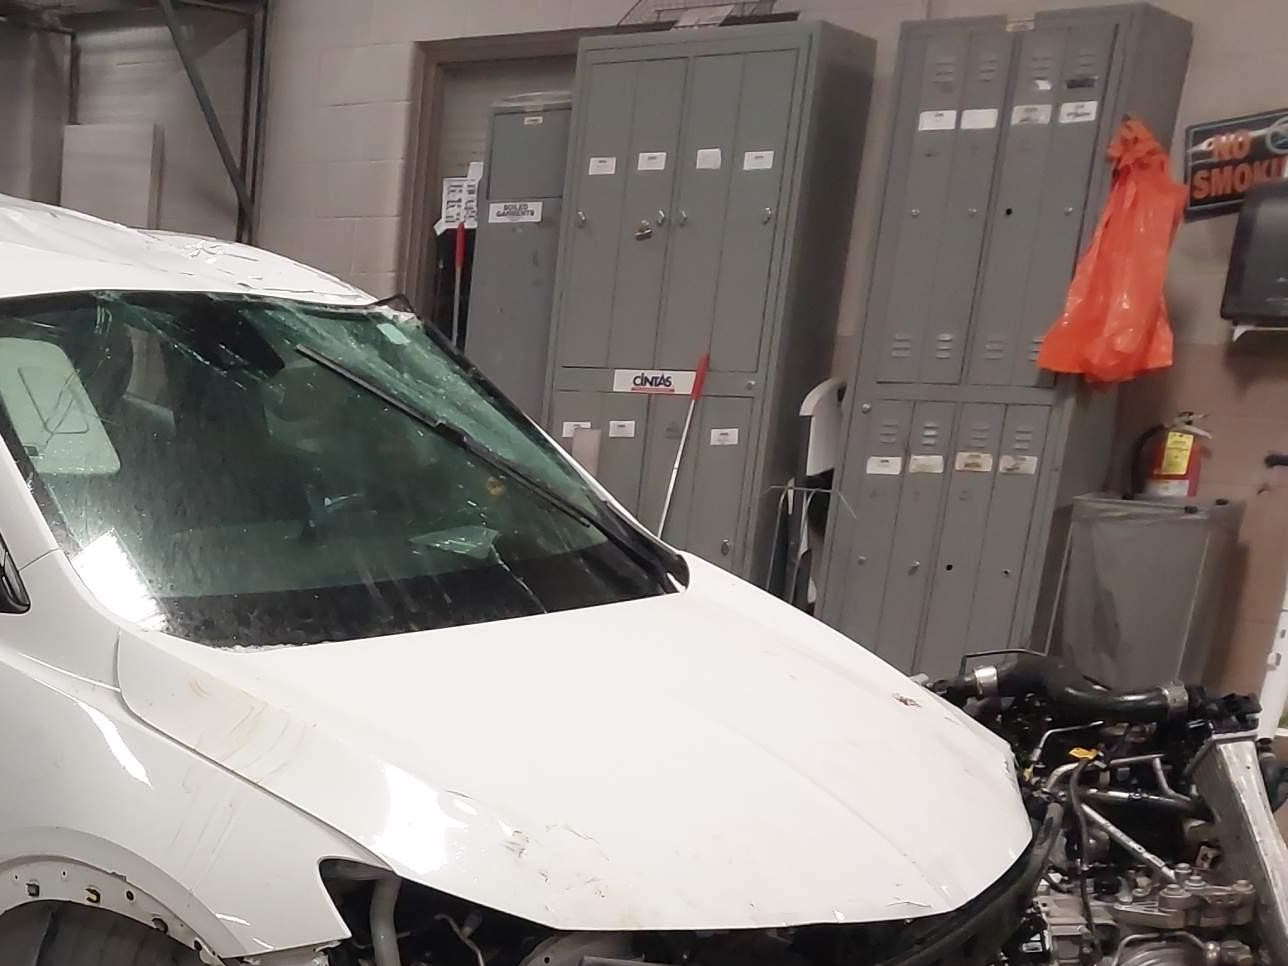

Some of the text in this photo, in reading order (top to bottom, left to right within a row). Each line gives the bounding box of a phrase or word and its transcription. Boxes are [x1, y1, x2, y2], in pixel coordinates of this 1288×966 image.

[1213, 129, 1251, 160] NO
[1192, 157, 1286, 199] SMOKI
[632, 372, 672, 387] CINTAS
